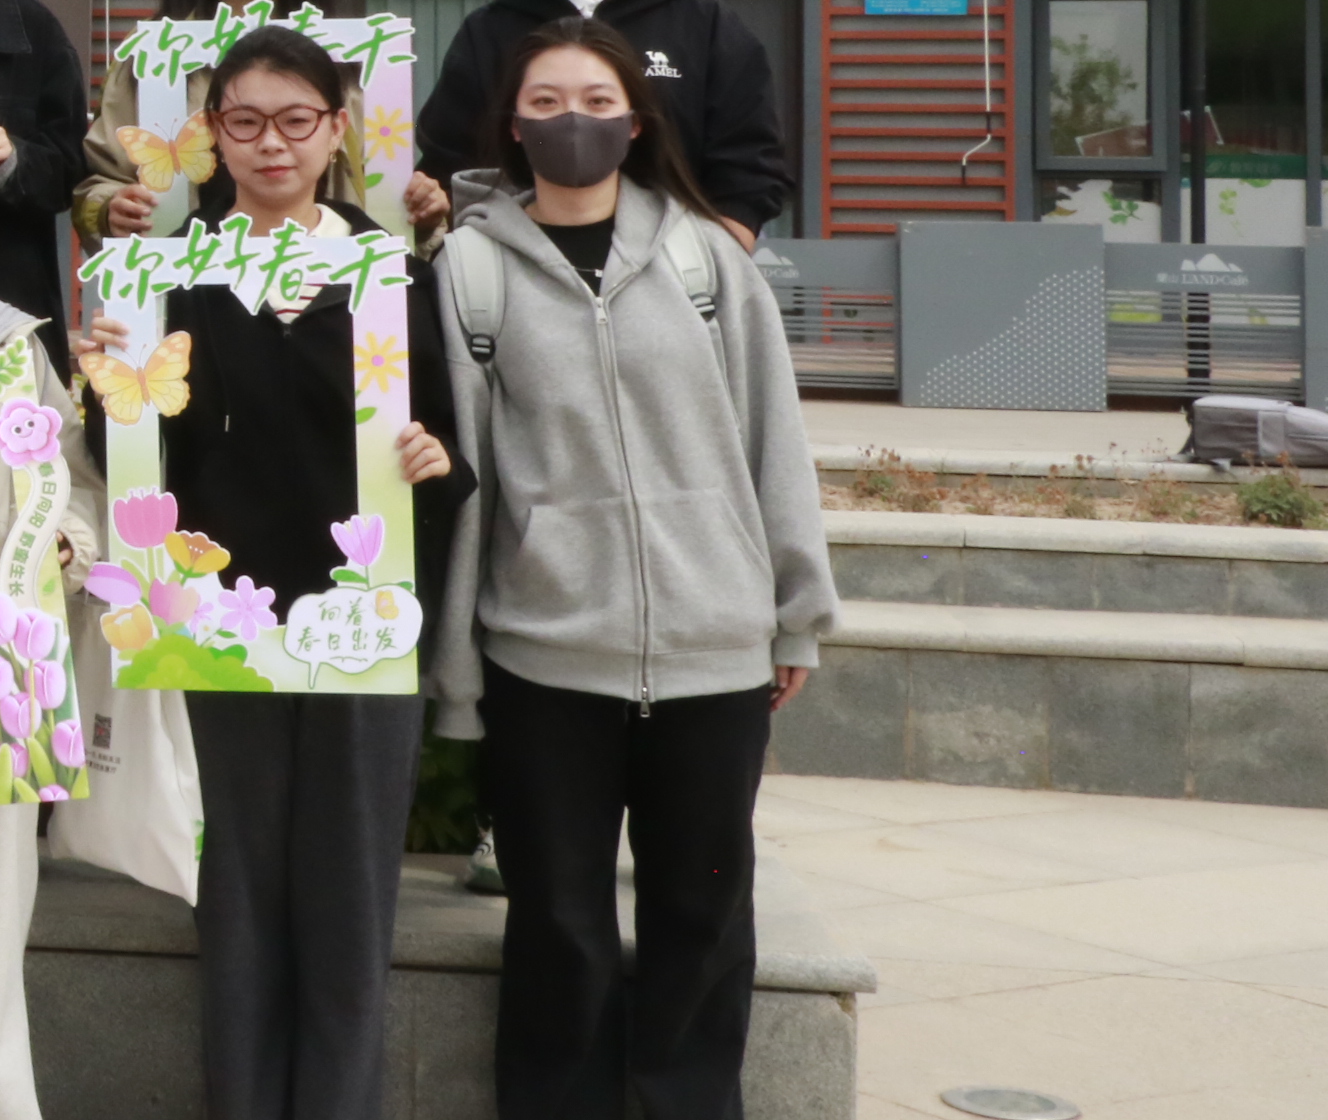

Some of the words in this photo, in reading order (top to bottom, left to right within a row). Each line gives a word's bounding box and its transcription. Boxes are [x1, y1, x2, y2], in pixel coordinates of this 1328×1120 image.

[644, 66, 682, 78] AMEL
[81, 216, 411, 313] 你好春天
